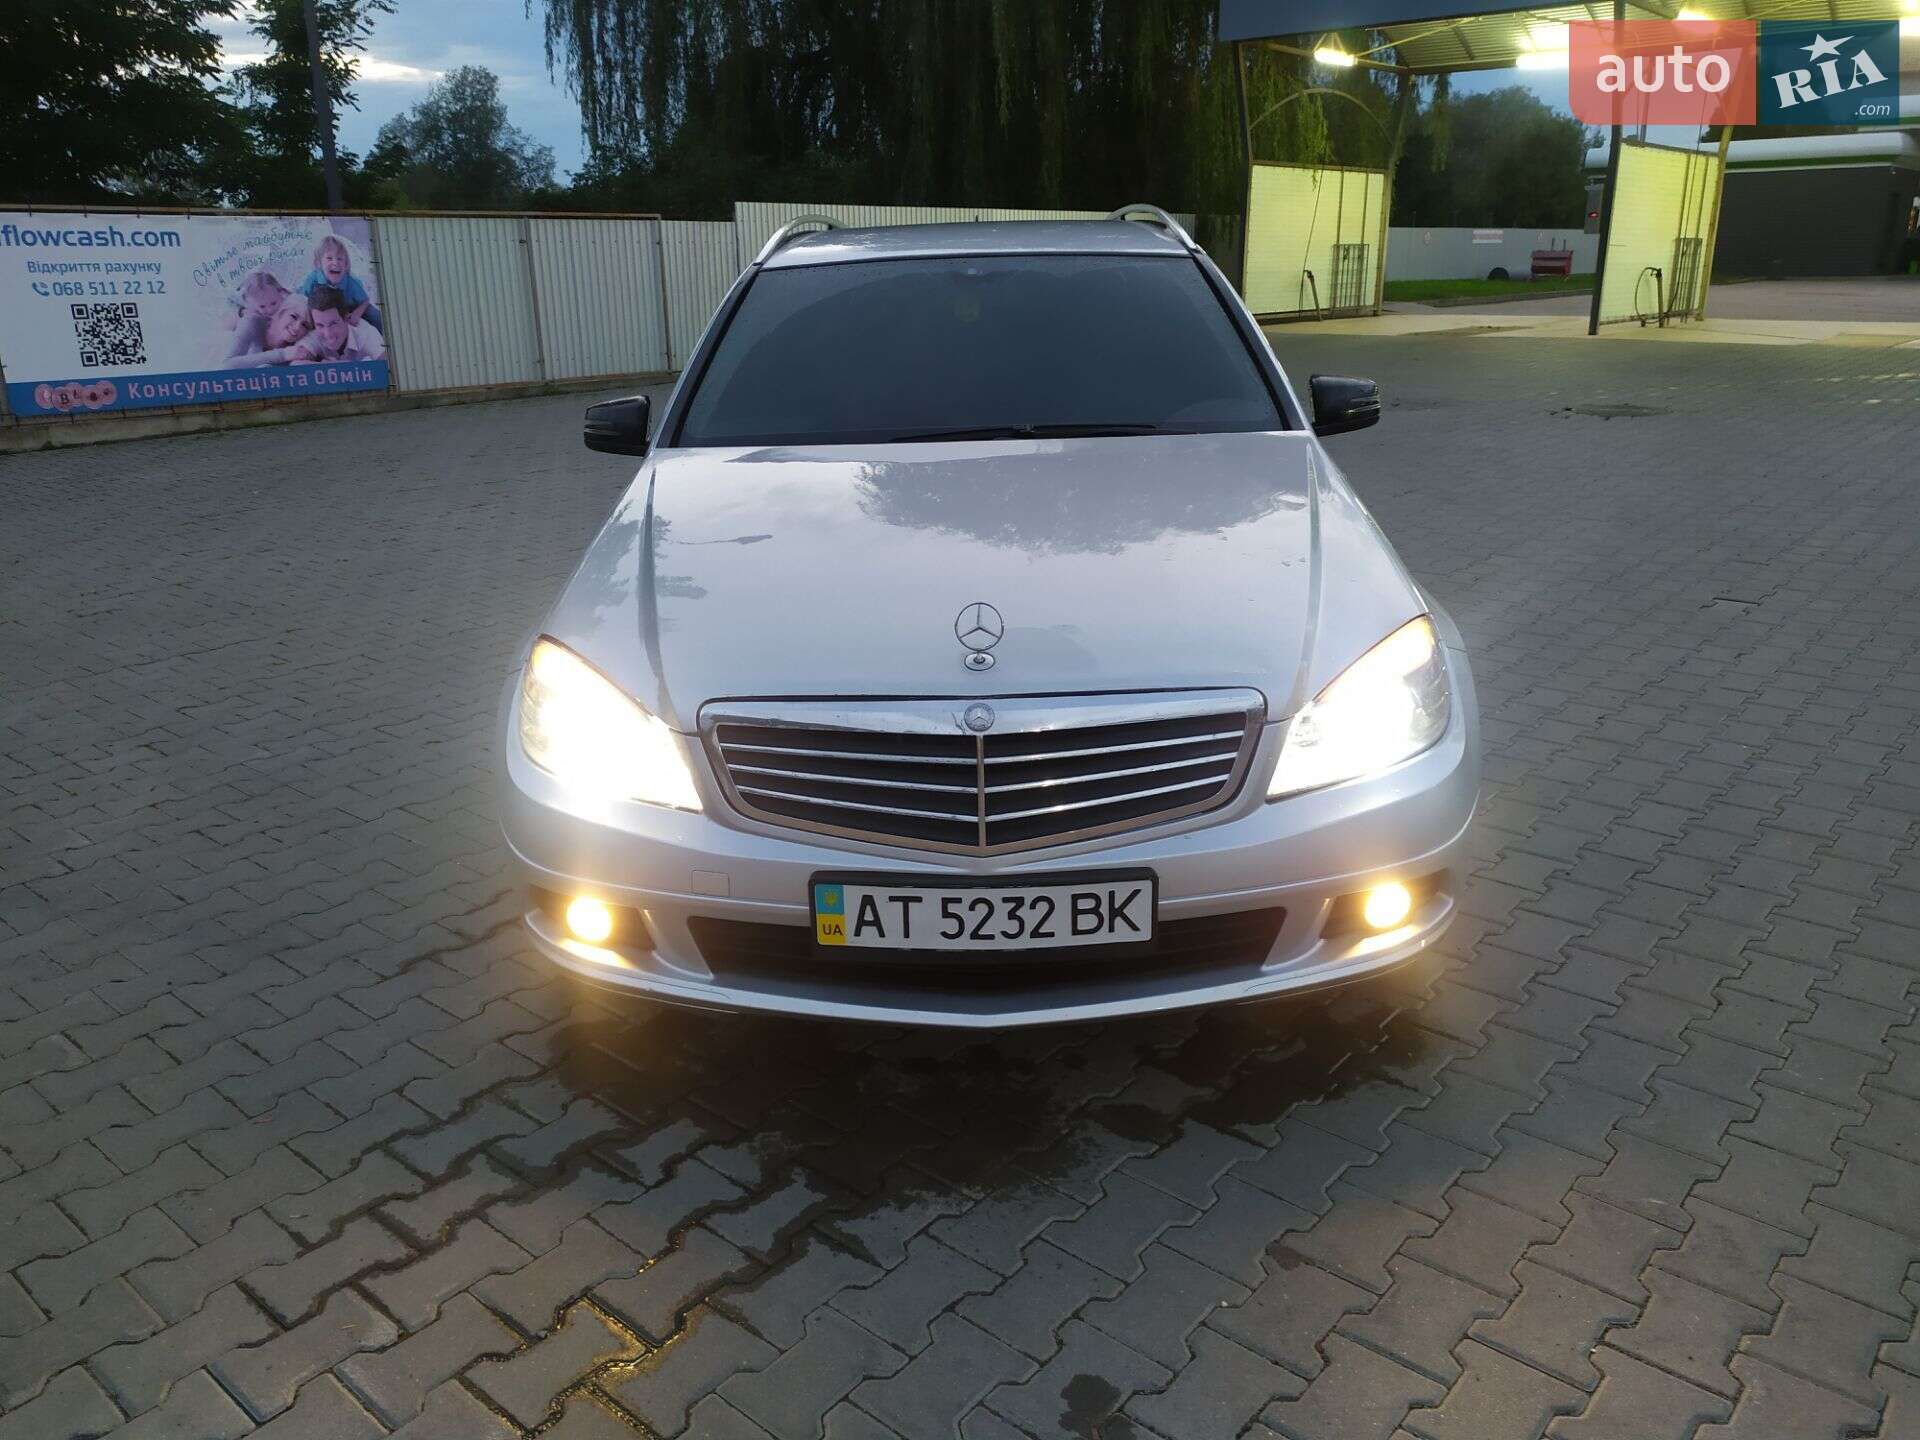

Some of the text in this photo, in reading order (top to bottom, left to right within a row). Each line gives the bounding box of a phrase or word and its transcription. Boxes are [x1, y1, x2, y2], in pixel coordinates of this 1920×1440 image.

[27, 261, 161, 275] Відкриття рахунку
[53, 280, 166, 297] 068 511 22 12
[128, 373, 280, 399] Консультація
[286, 373, 308, 388] та
[315, 367, 372, 385] Обмін
[853, 889, 1142, 940] AT 5232 BK
[823, 924, 843, 936] UA
